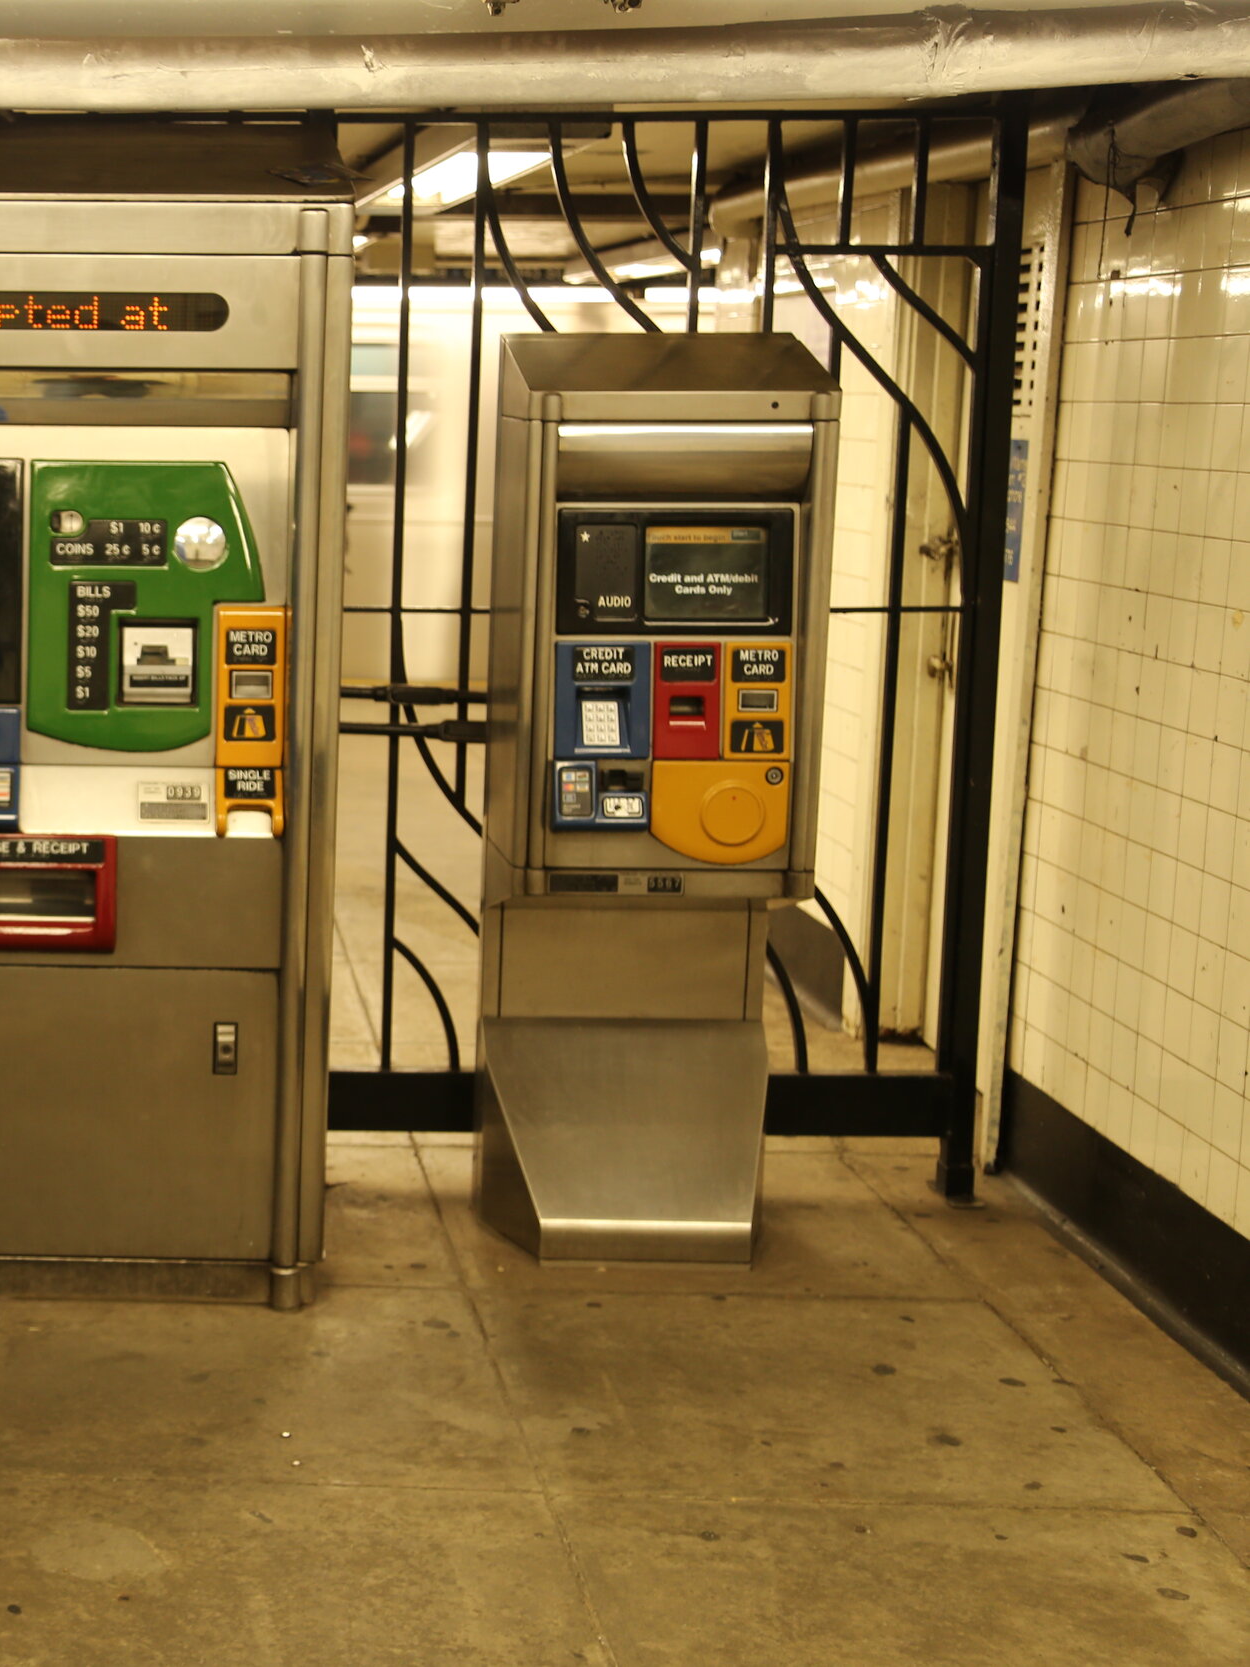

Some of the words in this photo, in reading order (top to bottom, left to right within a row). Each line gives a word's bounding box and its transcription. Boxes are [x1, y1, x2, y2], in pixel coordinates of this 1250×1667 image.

[120, 296, 168, 331] at
[110, 520, 124, 535] $1
[56, 543, 94, 555] COINS
[649, 573, 682, 583] Credit
[684, 573, 704, 583] and
[706, 573, 758, 584] ATM/debit
[76, 586, 111, 598] BILLS
[675, 584, 706, 594] Cards
[708, 584, 733, 596] Only
[598, 596, 632, 608] AUDIO
[76, 604, 100, 618] $50
[76, 624, 100, 638] $20
[229, 630, 273, 643] METRO
[76, 645, 97, 659] $10
[233, 643, 268, 657] CARD
[583, 647, 625, 660] CREDIT
[739, 649, 779, 662] METRO
[663, 654, 713, 667] RECEIPT
[76, 665, 92, 679] $5
[576, 662, 599, 674] ATM
[601, 662, 632, 675] CARD
[744, 664, 774, 676] CARD
[76, 685, 90, 699] $1
[227, 769, 271, 781] SINGLE
[236, 781, 265, 792] RIDE
[16, 841, 26, 854] &
[32, 841, 90, 855] RECEIPT
